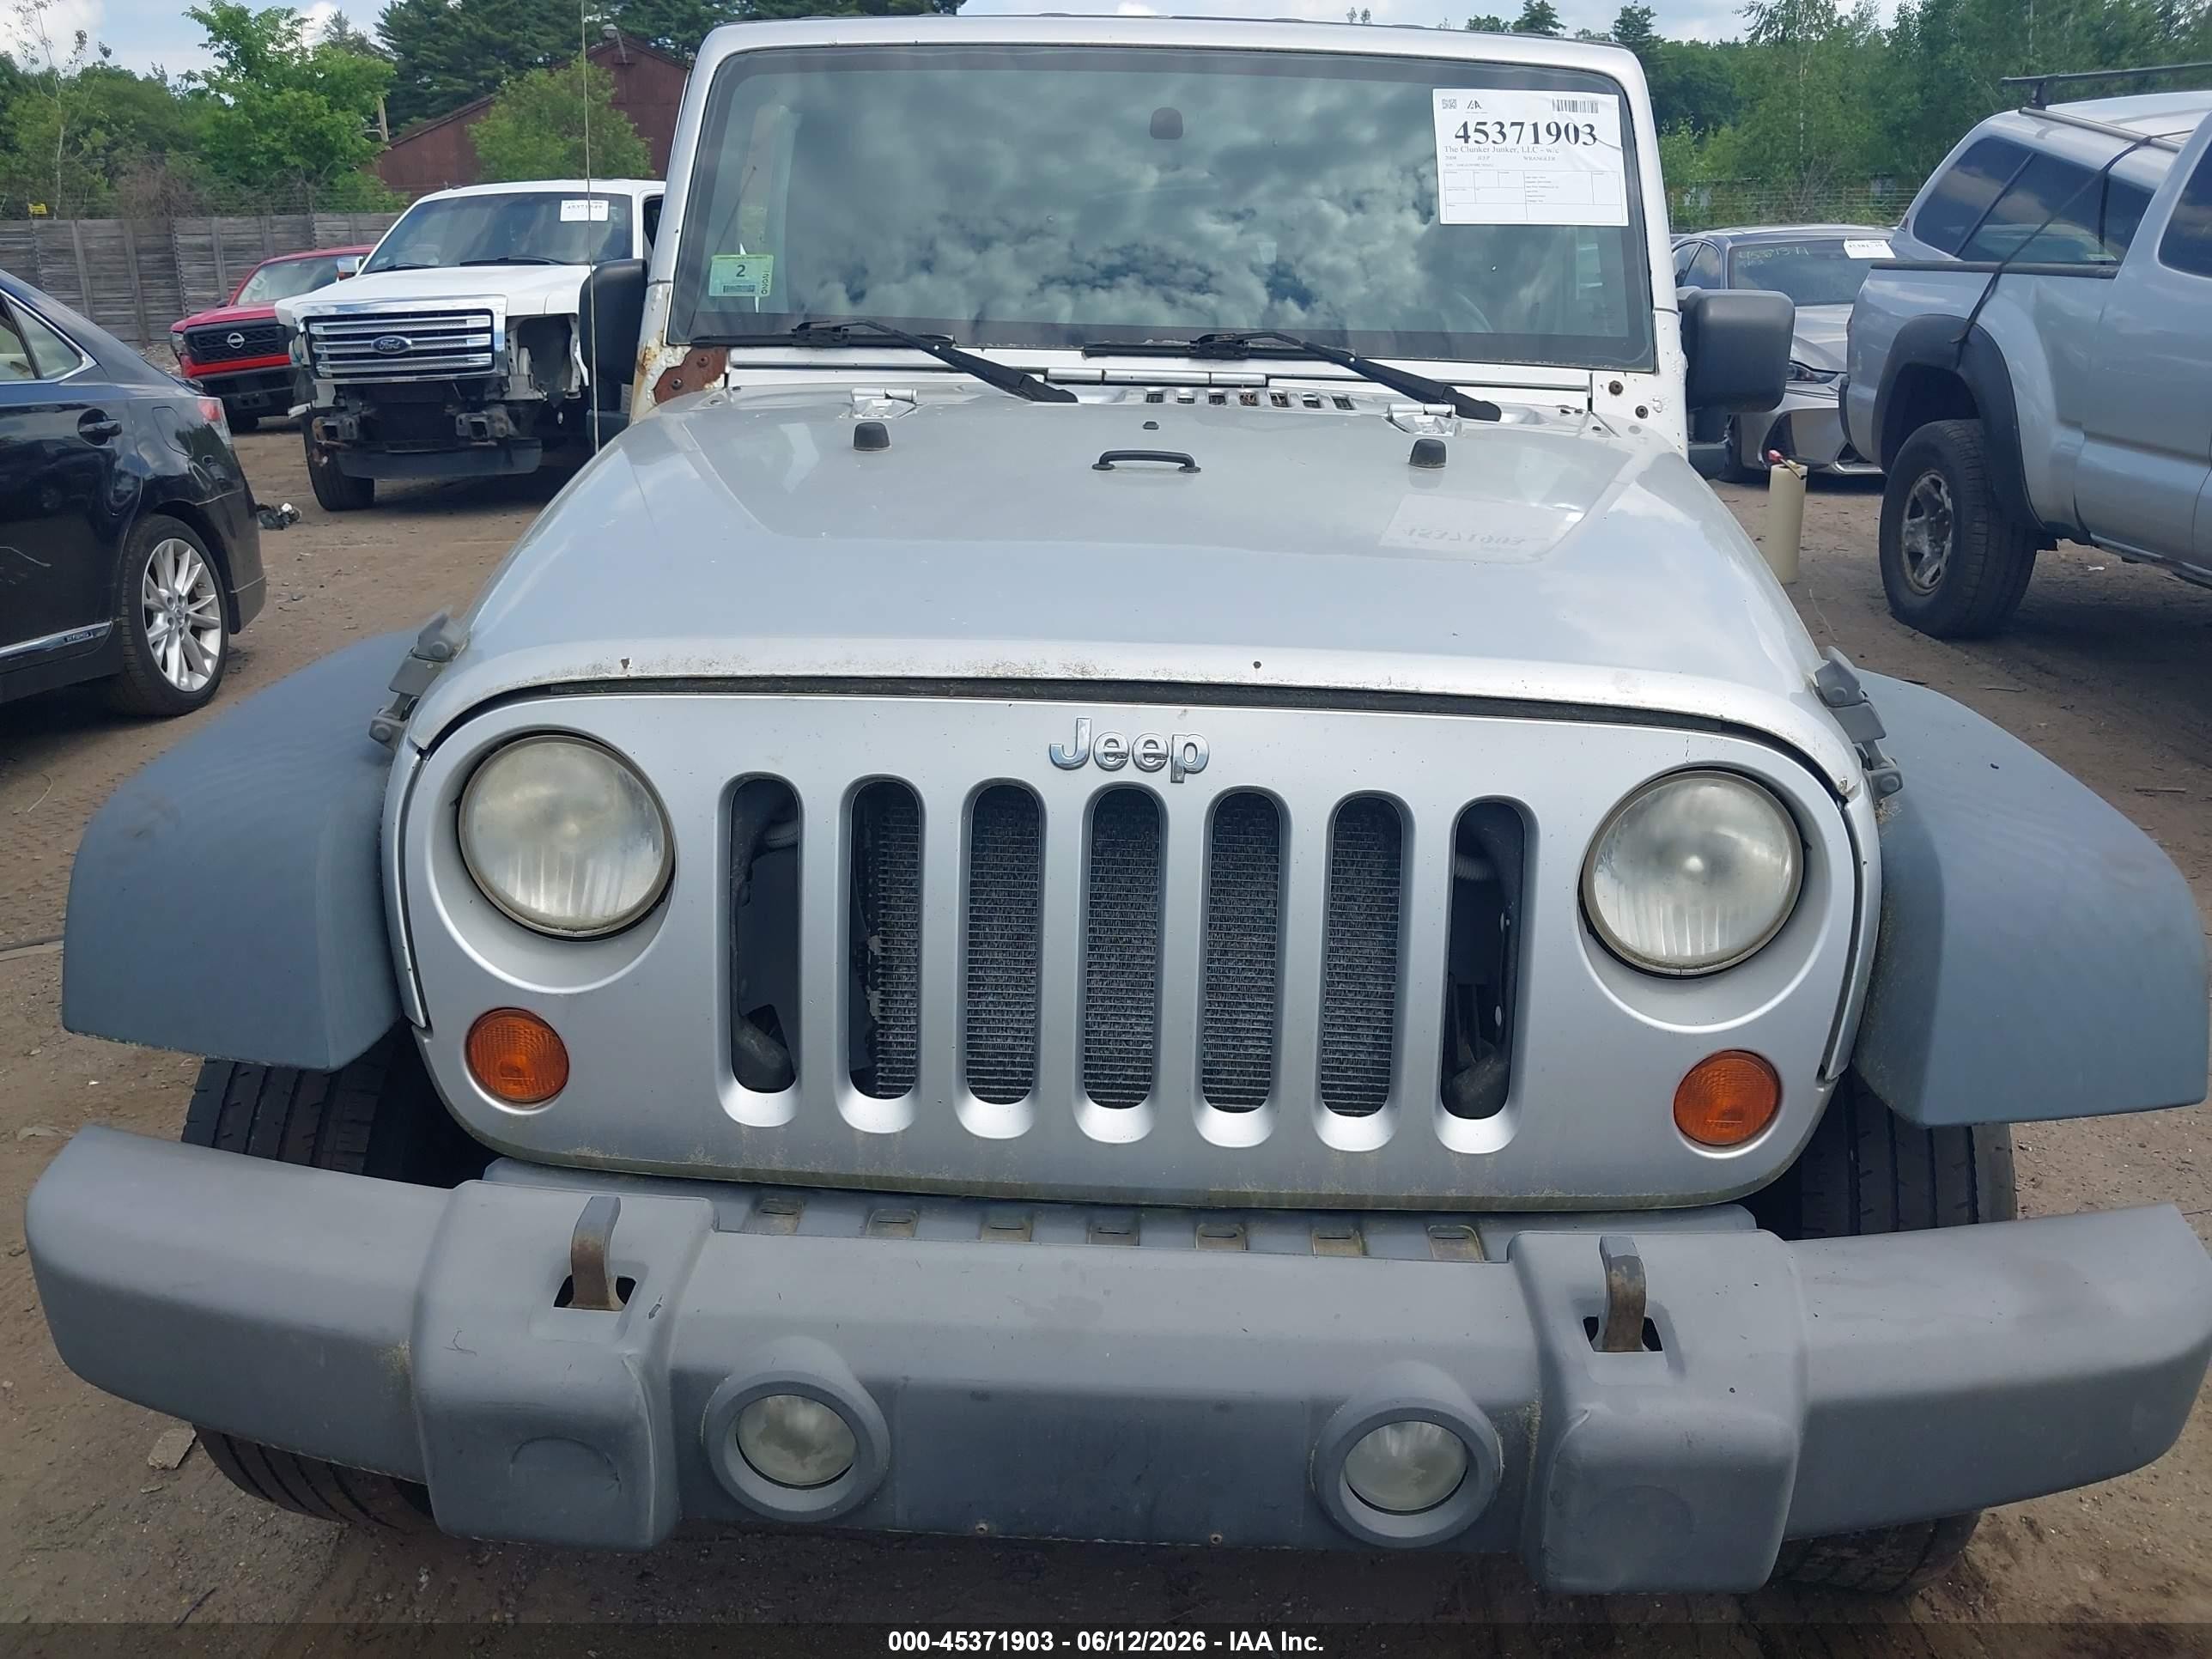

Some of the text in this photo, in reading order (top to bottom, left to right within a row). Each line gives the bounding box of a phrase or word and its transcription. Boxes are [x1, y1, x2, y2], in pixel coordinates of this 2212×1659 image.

[1455, 120, 1597, 147] 45371903
[736, 264, 745, 277] 2
[1049, 717, 1210, 783] Jeep
